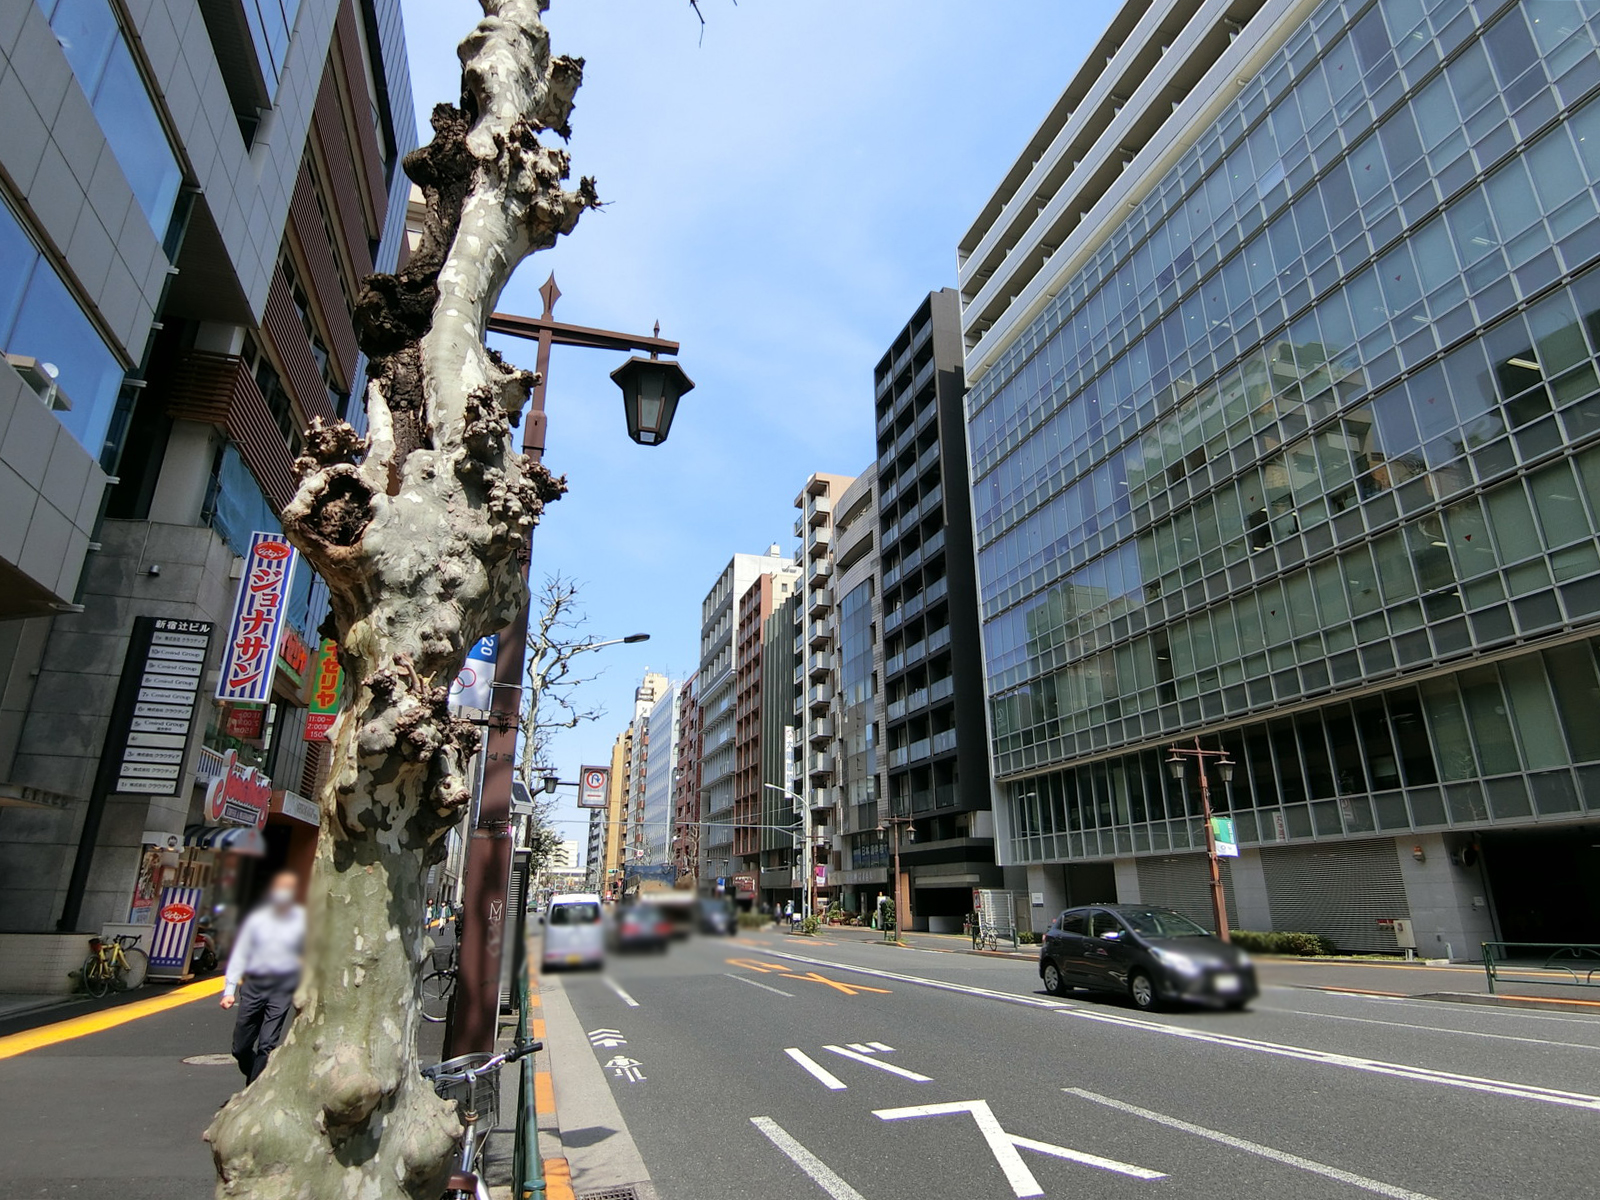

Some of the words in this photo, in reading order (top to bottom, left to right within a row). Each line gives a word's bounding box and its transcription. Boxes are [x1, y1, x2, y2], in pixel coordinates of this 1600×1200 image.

[155, 619, 211, 633] 新宿辻ビル
[229, 568, 283, 689] ジョナサン
[481, 634, 495, 656] 20
